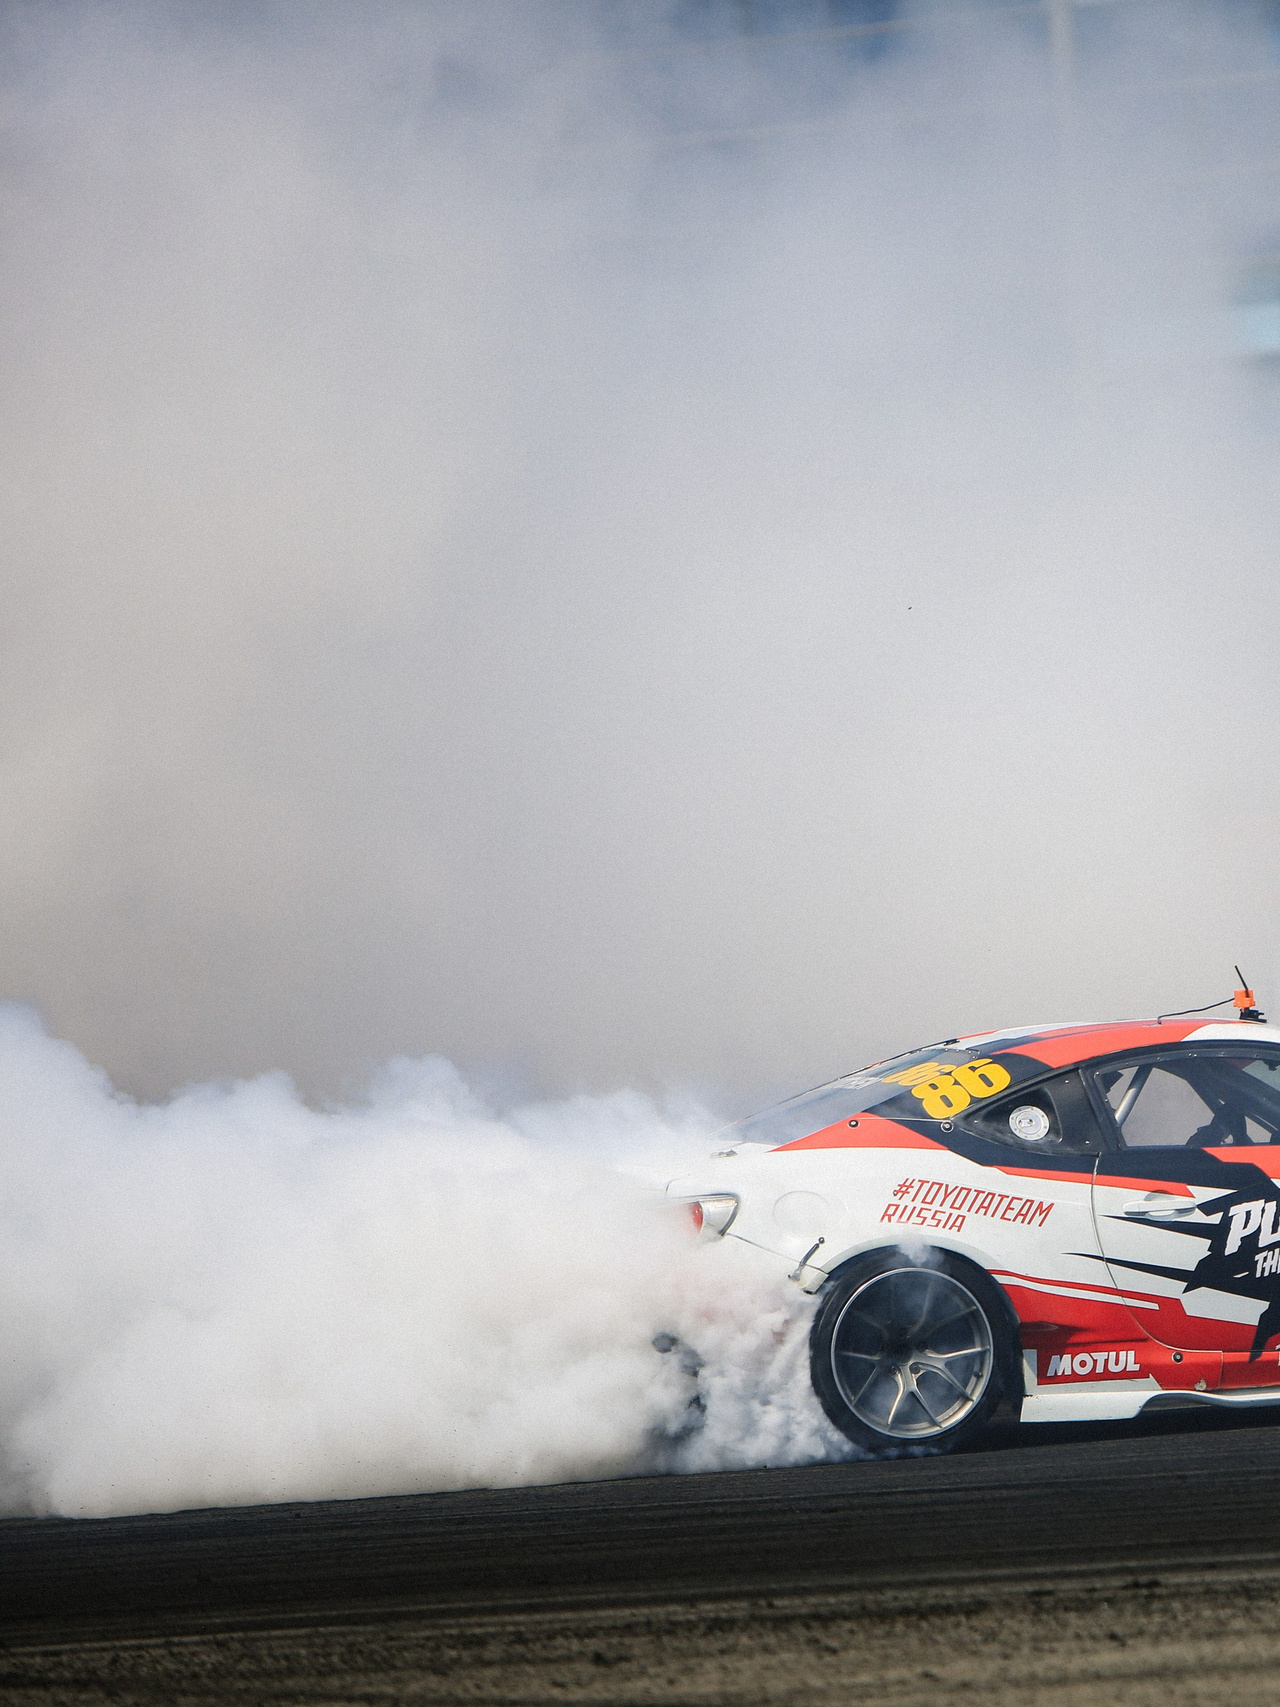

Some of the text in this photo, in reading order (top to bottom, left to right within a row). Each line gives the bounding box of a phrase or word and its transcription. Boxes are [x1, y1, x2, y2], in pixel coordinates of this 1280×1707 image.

[911, 1058, 1011, 1119] 86
[879, 1203, 967, 1233] RUSSIA
[893, 1178, 1055, 1228] #TOYOTATEAM
[1047, 1350, 1140, 1377] MOTUL
